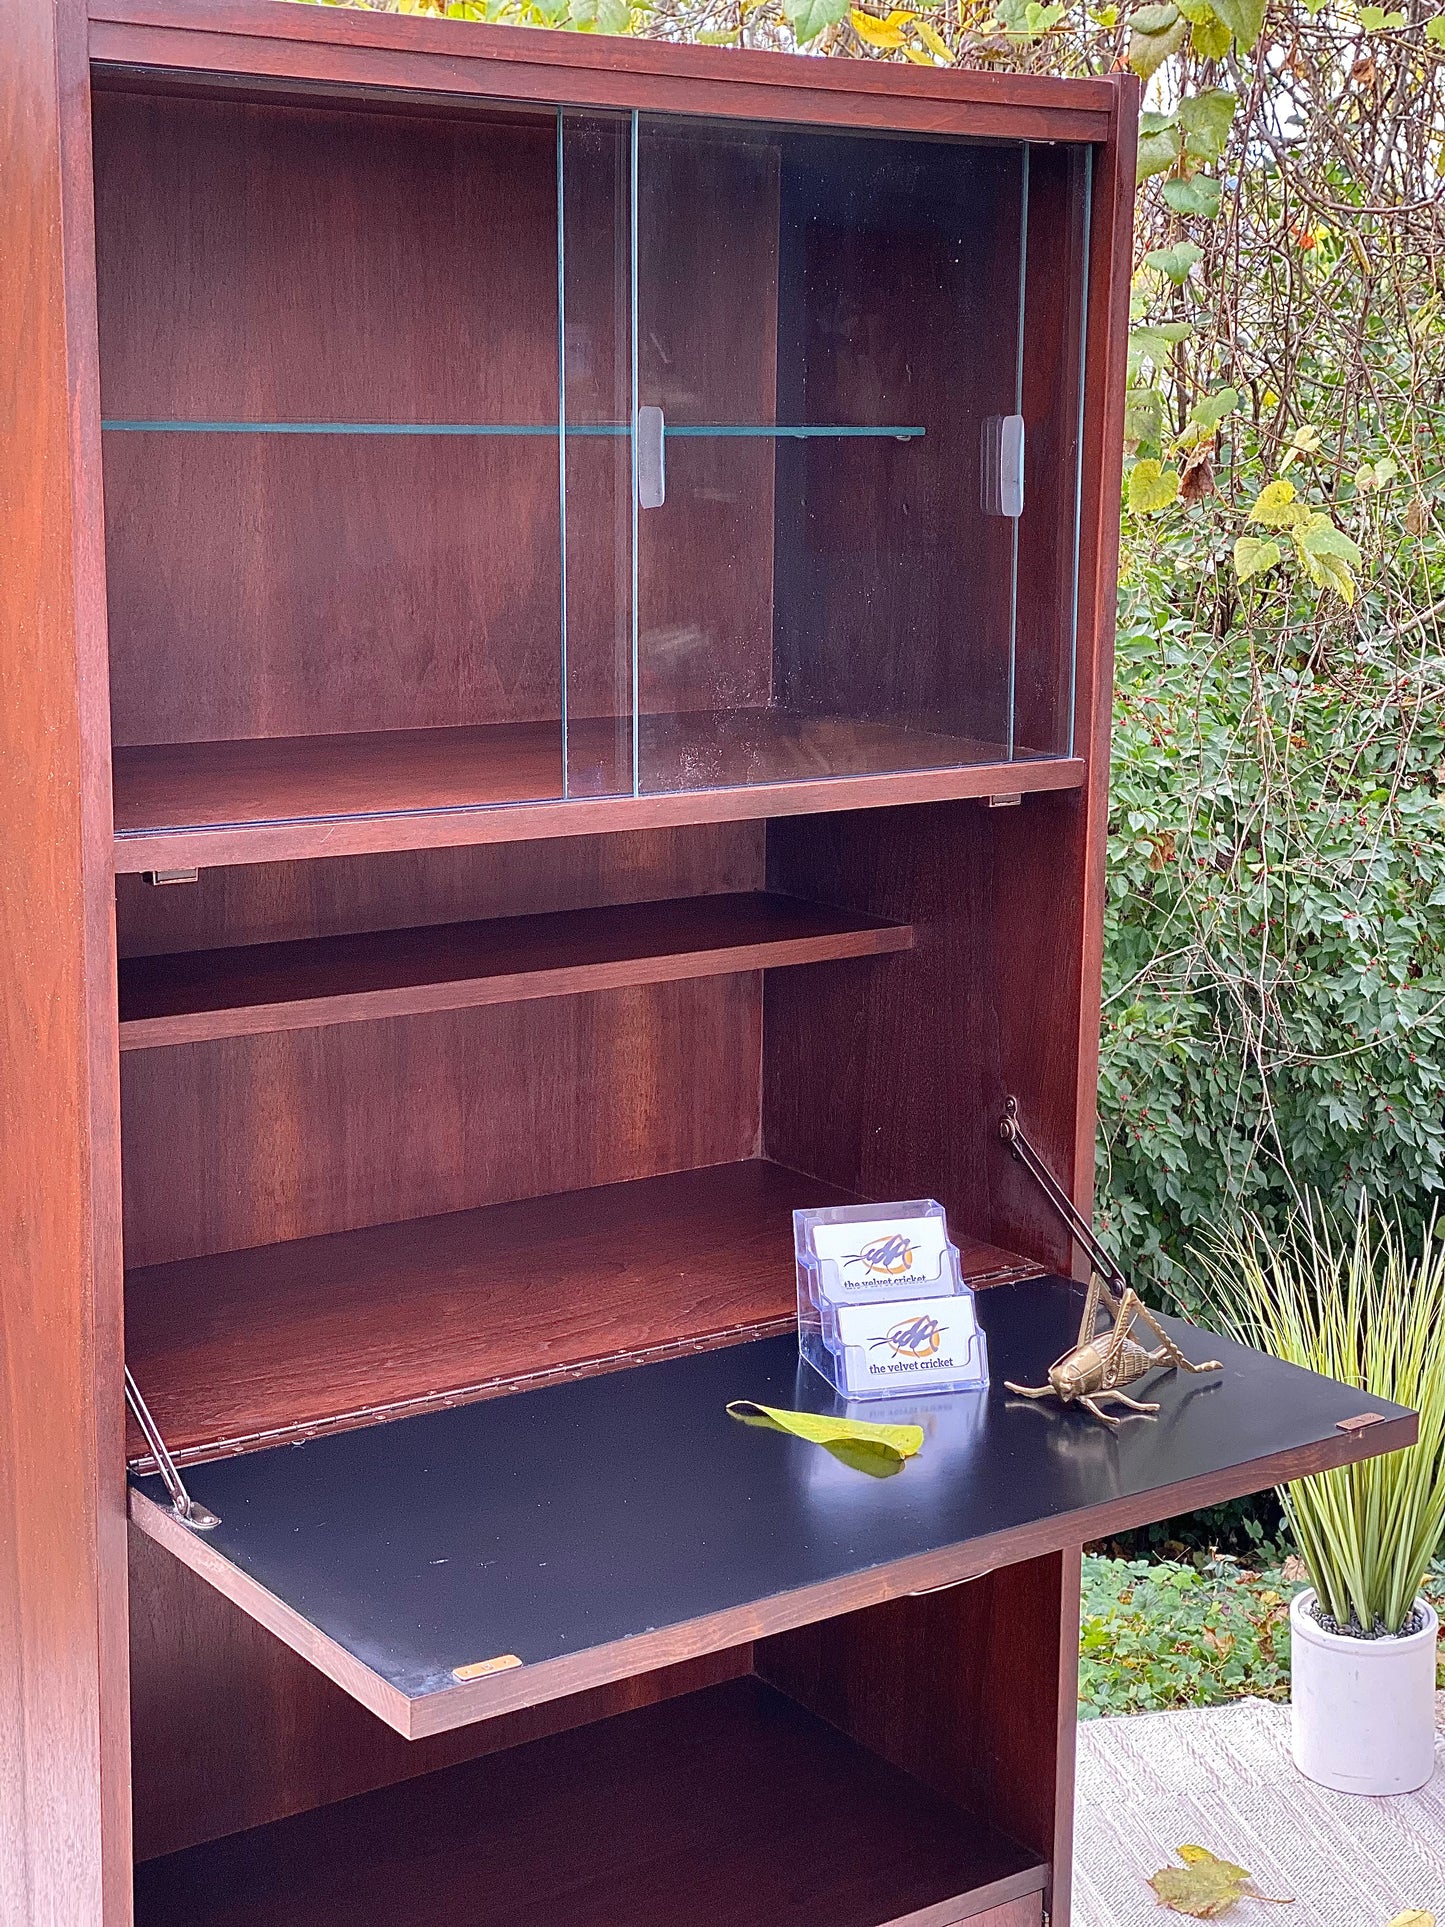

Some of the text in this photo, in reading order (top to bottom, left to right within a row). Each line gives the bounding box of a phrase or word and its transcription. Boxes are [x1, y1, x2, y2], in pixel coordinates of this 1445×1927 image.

[844, 1275, 926, 1289] the velvet cricket
[869, 1357, 954, 1374] the velvet cricket
